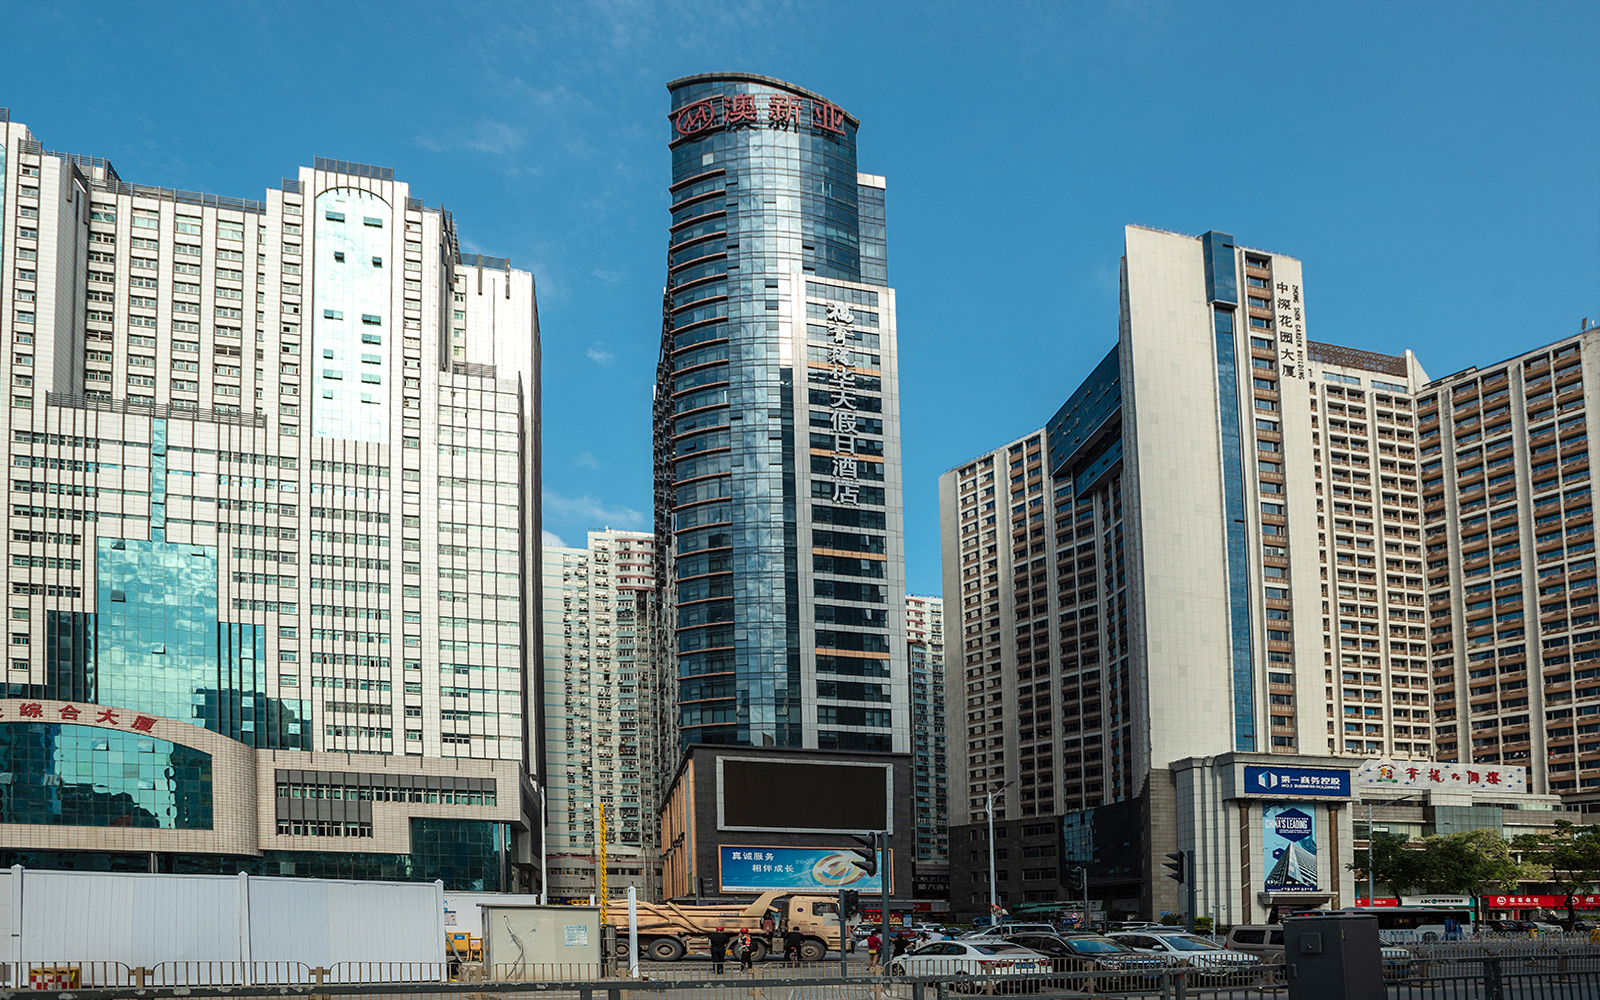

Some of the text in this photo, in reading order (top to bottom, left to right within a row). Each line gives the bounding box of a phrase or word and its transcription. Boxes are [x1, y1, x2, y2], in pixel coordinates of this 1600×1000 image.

[723, 93, 846, 136] 澳新亚
[1277, 281, 1296, 379] 中深花园大厦
[1297, 350, 1305, 380] BUILDING
[0, 702, 158, 733] 综合大厦
[1281, 775, 1340, 786] 第一商务控股
[731, 851, 775, 862] 真诚服务
[751, 864, 795, 873] 相伴成长
